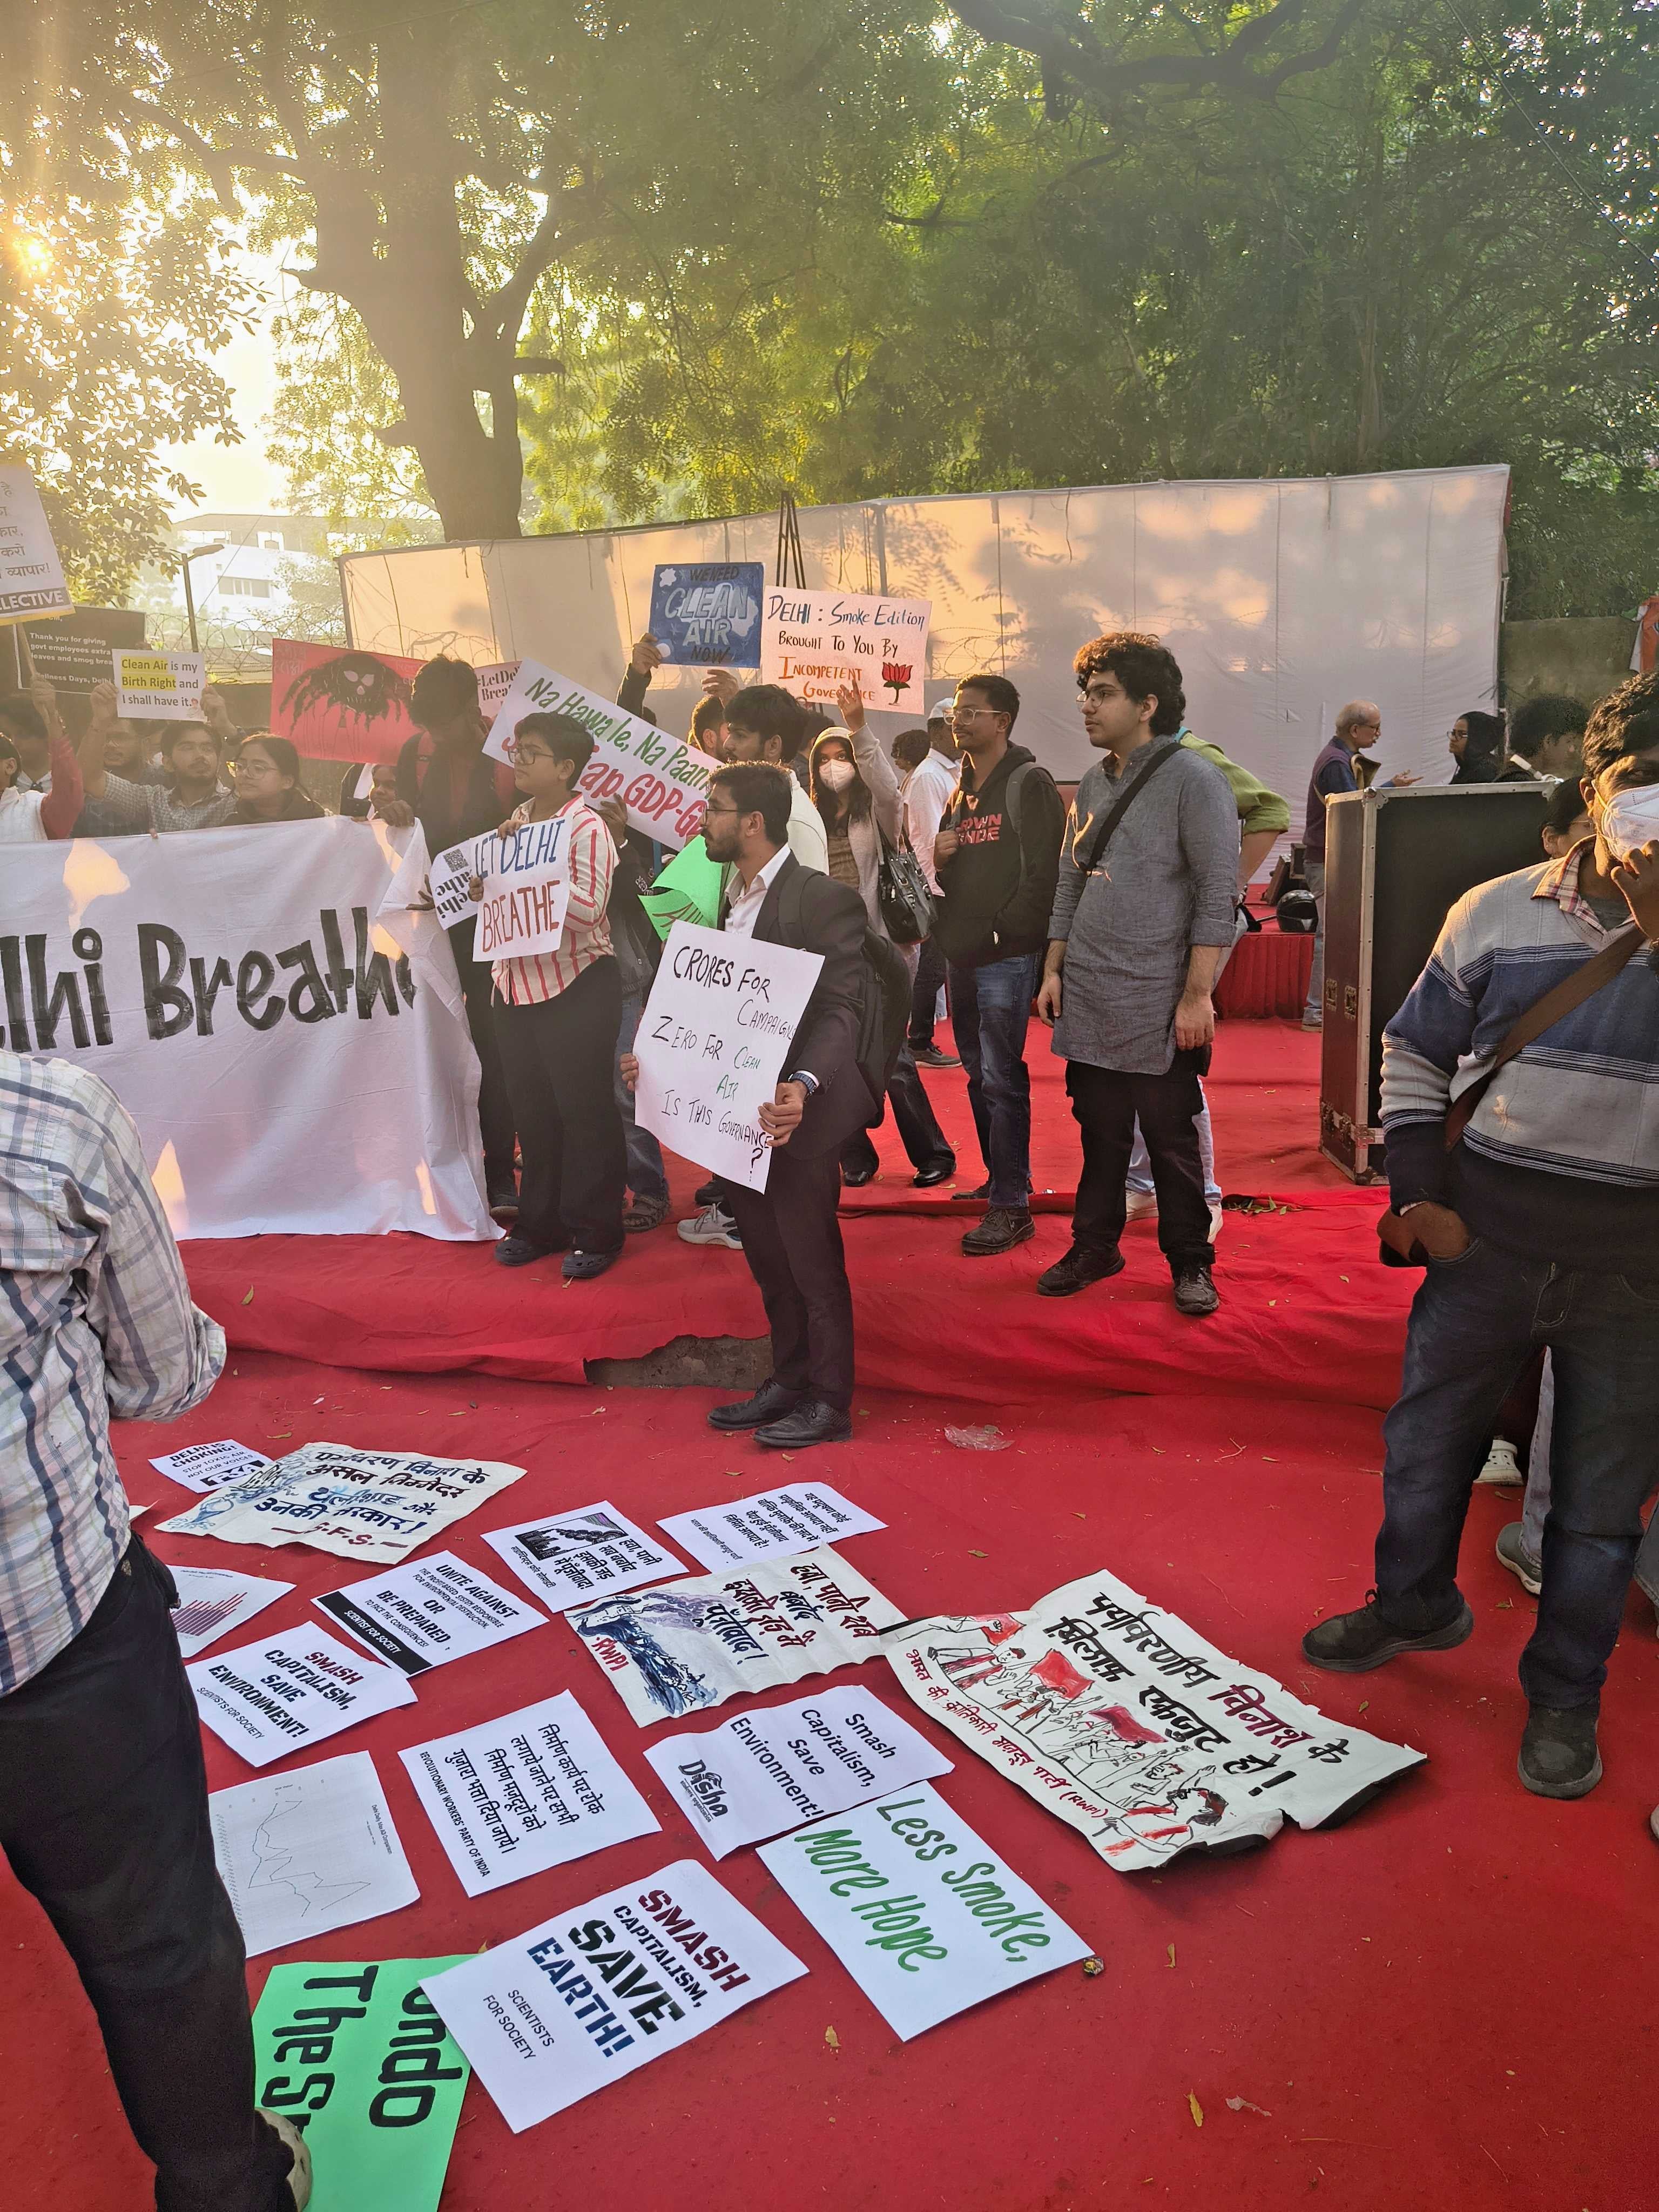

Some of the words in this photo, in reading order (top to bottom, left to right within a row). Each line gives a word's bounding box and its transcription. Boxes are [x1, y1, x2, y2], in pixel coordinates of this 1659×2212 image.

[0, 590, 63, 611] LECTIVE
[665, 584, 748, 619] CLEAN
[768, 595, 811, 623] DELHI
[828, 601, 870, 626] Smoke
[874, 604, 925, 632] Edition
[30, 632, 53, 640] Thank
[83, 638, 106, 646] giving
[49, 645, 89, 654] employees
[683, 619, 732, 646] AIR
[122, 659, 150, 669] Clean
[153, 661, 167, 670] Air
[171, 662, 178, 671] is
[181, 663, 197, 673] my
[691, 648, 730, 663] NOW
[122, 677, 146, 686] Birth
[151, 678, 176, 689] Right
[179, 680, 198, 689] and
[123, 695, 125, 704] I
[129, 696, 151, 705] shall
[155, 696, 178, 706] have
[181, 697, 192, 706] it.
[525, 677, 559, 706] Na
[633, 731, 664, 766] Na
[475, 833, 498, 880] LET
[501, 819, 565, 874] DELHI
[482, 880, 561, 953] BREATHE
[673, 946, 734, 989] CRORES
[651, 1016, 697, 1049] ZERO
[716, 1075, 739, 1101] AIR
[662, 1090, 681, 1116] IS
[689, 1099, 712, 1127] THIS
[719, 1111, 772, 1150] GOVERNANCE
[170, 1446, 210, 1461] DELHI
[172, 1446, 237, 1467] CHOKING!
[183, 1464, 202, 1473] STOP
[204, 1455, 230, 1465] TOXIC
[205, 1464, 222, 1472] OUR
[225, 1454, 254, 1464] VOICES
[412, 1574, 426, 1584] FOR
[422, 1581, 459, 1608] ENVIRONMENTAL
[455, 1604, 488, 1629] DESTRUCTION.
[419, 1568, 432, 1579] THE
[454, 1593, 478, 1608] SYSTEM
[471, 1603, 505, 1628] RESPONSIBLE
[423, 1599, 446, 1615] OR
[436, 1564, 474, 1587] UNITE
[464, 1585, 520, 1618] AGAINST
[343, 1610, 370, 1631] SCIENTIST
[366, 1627, 380, 1638] FOR
[377, 1634, 402, 1654] SOCIETY
[370, 1603, 385, 1616] FACE
[380, 1610, 394, 1621] THE
[389, 1617, 430, 1648] CONSEQUENCES!
[376, 1590, 397, 1604] BE
[391, 1599, 451, 1644] PREPARED
[260, 1674, 307, 1703] SAVE
[264, 1649, 358, 1711] CAPITALISM,
[304, 1651, 364, 1686] SMASH
[197, 1687, 229, 1710] SCIENTISTS
[226, 1704, 240, 1719] FOR
[235, 1714, 266, 1740] SOCIETY
[208, 1664, 311, 1738] ENVIRONMENT!
[537, 1723, 569, 1759] निर्माण
[844, 1712, 895, 1760] Smash
[1206, 1682, 1316, 1750] विनाश
[1306, 1737, 1352, 1764] के
[510, 1734, 543, 1768] लगाये
[558, 1752, 588, 1778] कार्य
[730, 1716, 825, 1818] Environment!
[787, 1737, 825, 1777] Save
[801, 1708, 875, 1789] Capitalism,
[484, 1748, 515, 1782] निर्माण
[521, 1813, 547, 1833] को
[529, 1764, 556, 1788] जाने
[542, 1784, 560, 1803] पर
[572, 1776, 592, 1796] पर
[678, 1759, 729, 1818] Disha
[419, 1751, 448, 1796] REVOLUTIONARY
[458, 1825, 476, 1849] PARTY
[468, 1847, 480, 1858] OF
[474, 1856, 490, 1877] INDIA
[477, 1799, 502, 1826] दिया
[549, 1798, 580, 1826] सभी
[580, 1790, 605, 1815] रोक
[876, 1798, 958, 1861] Less
[941, 1862, 1051, 1961] Smoke,
[793, 1829, 889, 1898] More
[850, 1894, 948, 1972] Hope
[612, 1905, 709, 2009] CAPITALISM,
[638, 1889, 751, 1993] SMASH
[526, 1936, 636, 2058] EARTH!
[567, 1919, 687, 2036] SAVE
[482, 1994, 502, 2017] FOR
[496, 2015, 537, 2061] SOCIETY
[507, 1988, 555, 2048] SCIENTISTS
